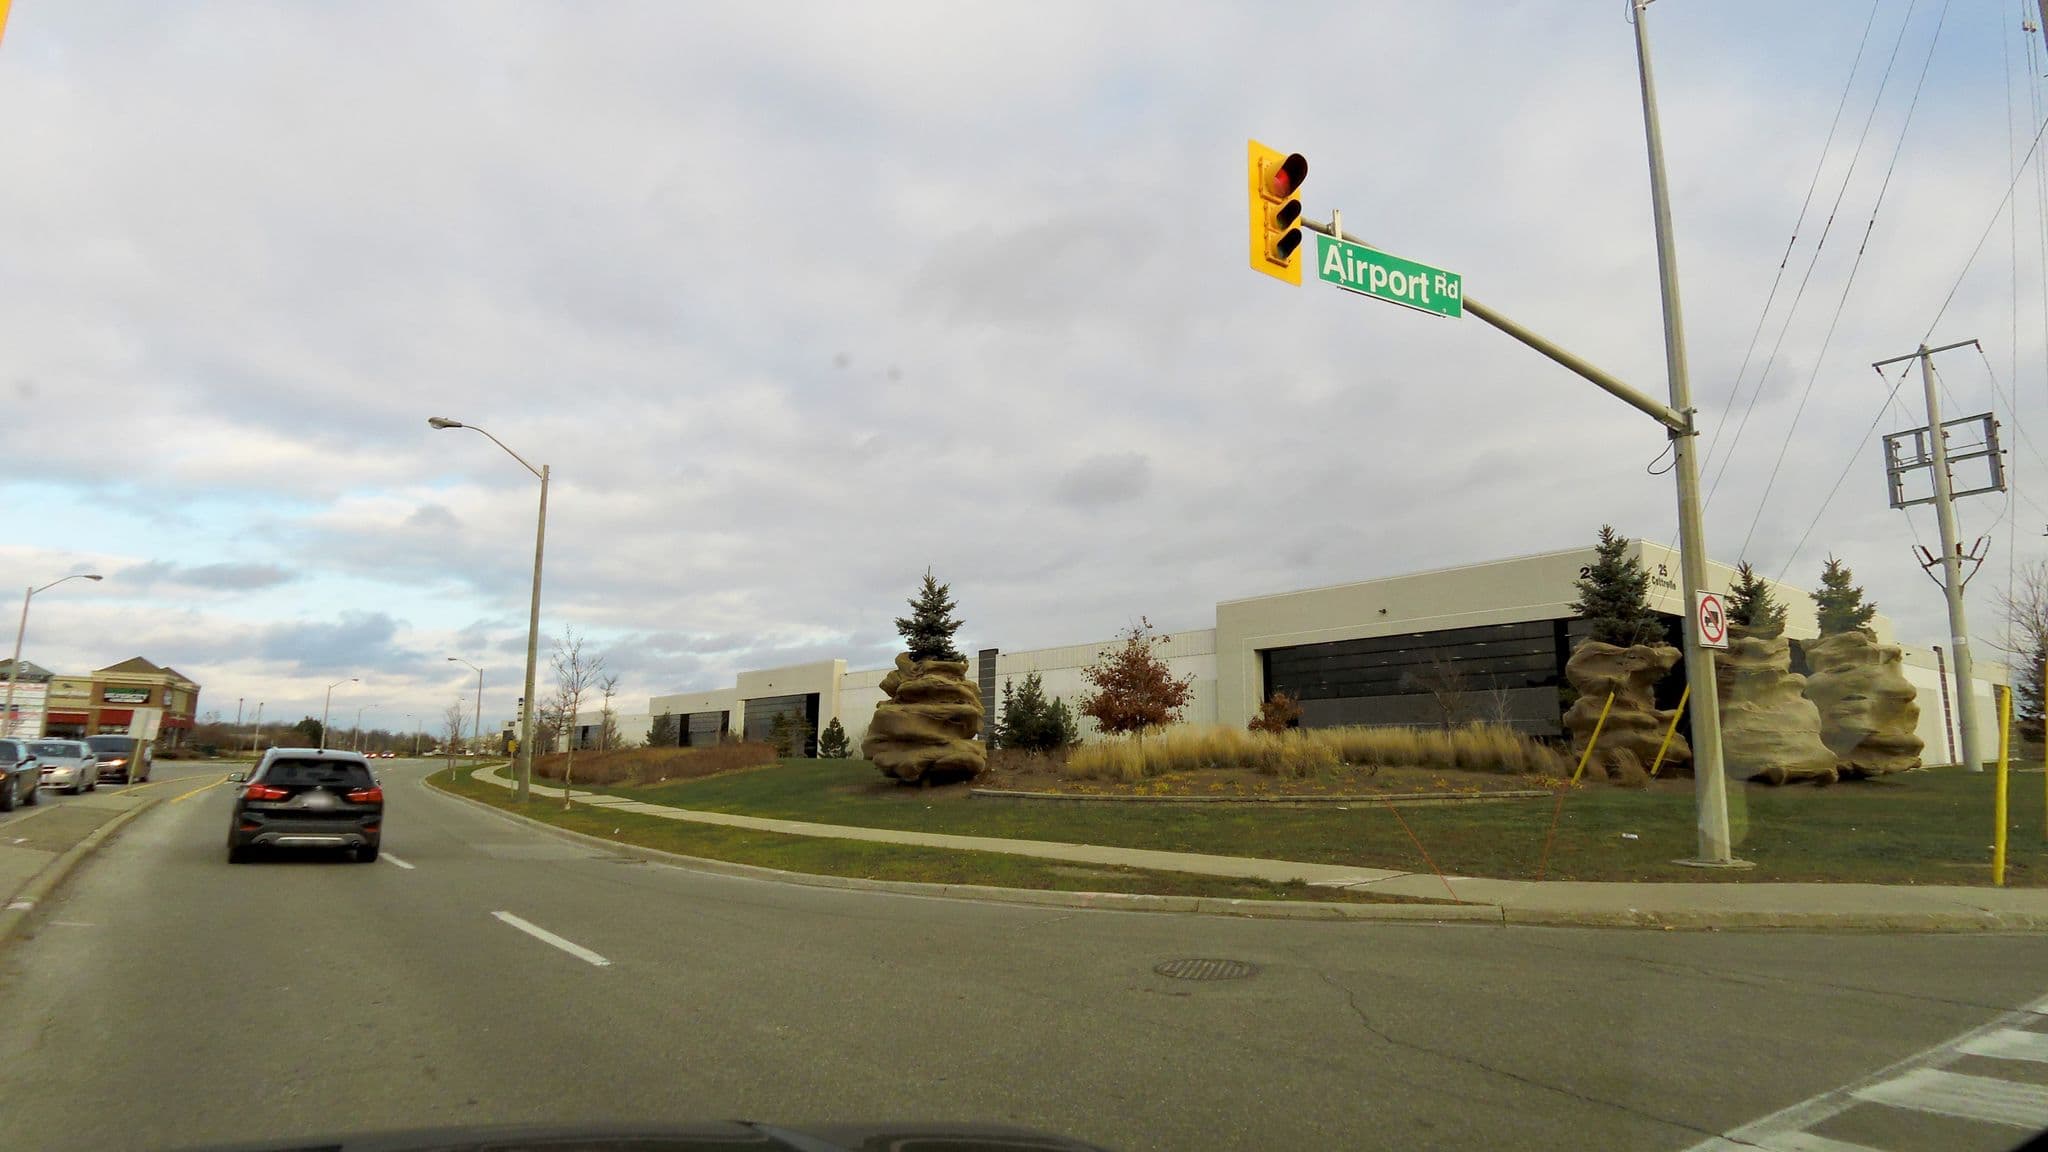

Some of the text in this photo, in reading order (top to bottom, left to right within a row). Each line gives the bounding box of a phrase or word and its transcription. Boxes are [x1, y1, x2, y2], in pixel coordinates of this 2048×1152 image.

[1323, 245, 1458, 304] Airport Rd
[1658, 564, 1667, 577] 25
